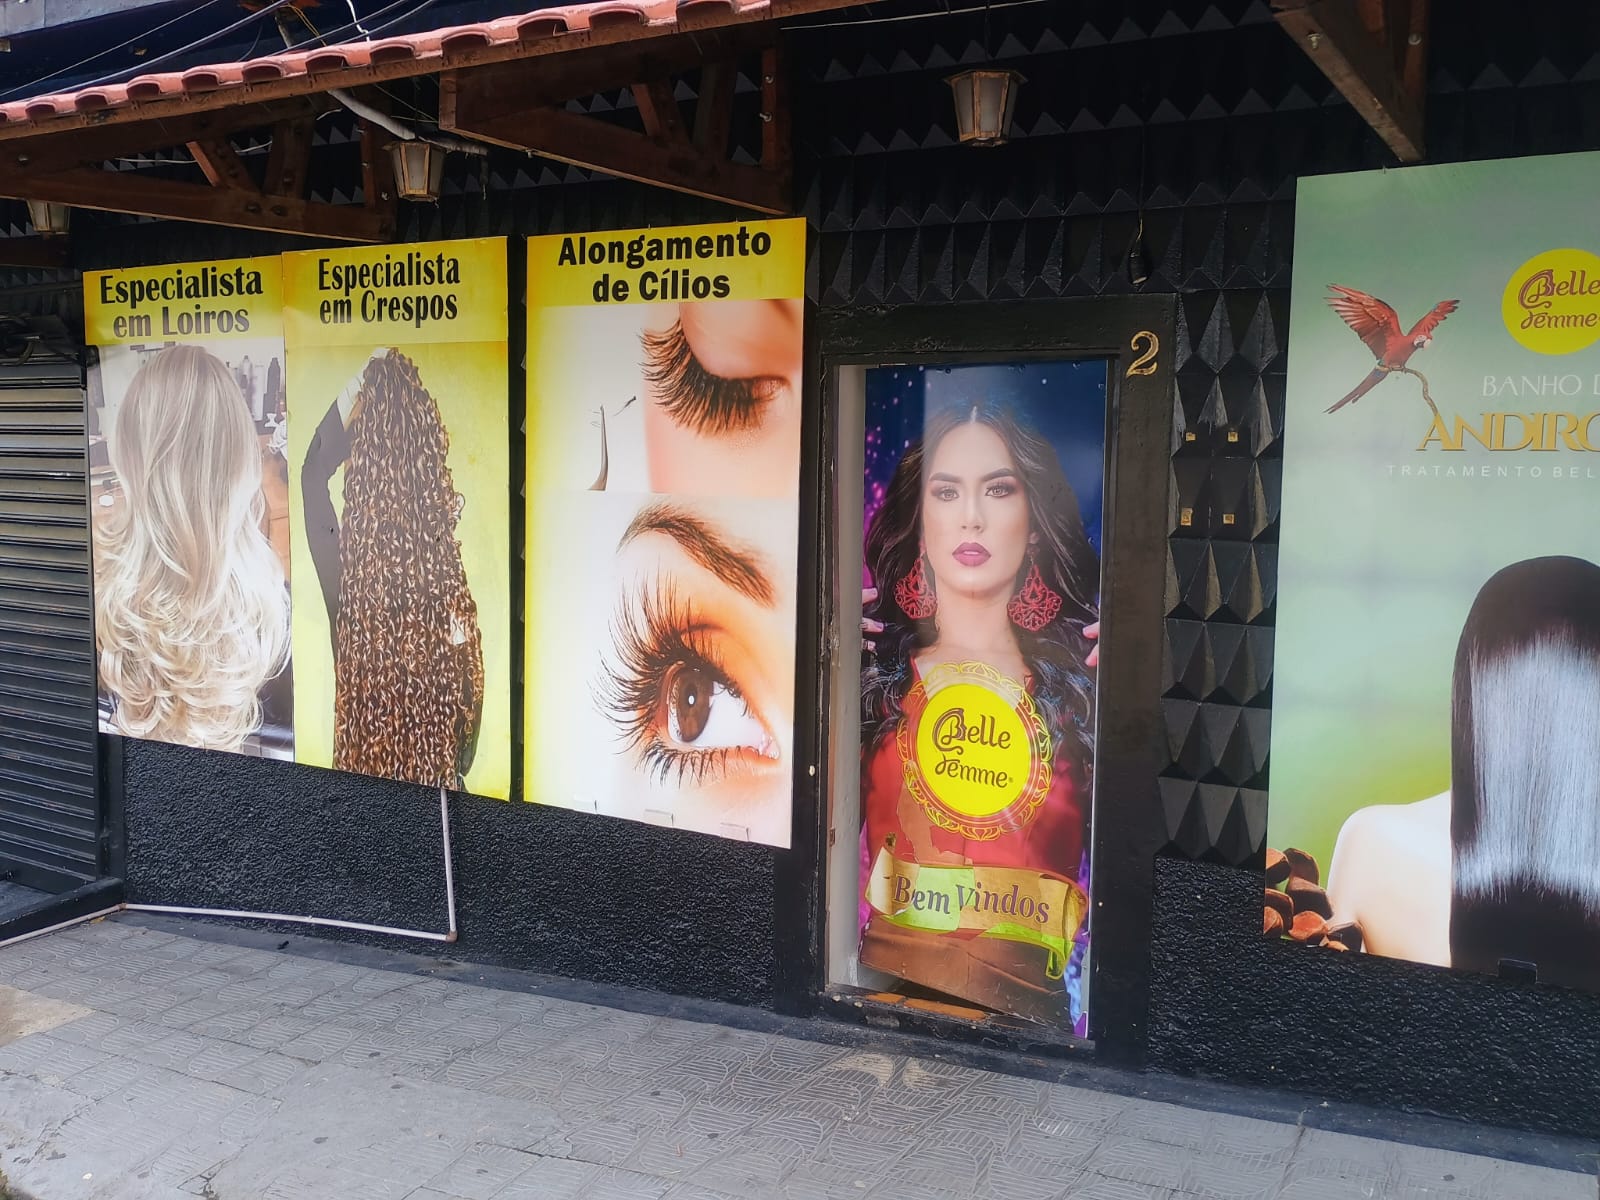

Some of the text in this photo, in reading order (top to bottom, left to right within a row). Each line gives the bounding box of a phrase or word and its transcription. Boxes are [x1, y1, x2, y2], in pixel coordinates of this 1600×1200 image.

[558, 226, 772, 269] Alongamento
[100, 267, 264, 308] Especialista
[318, 252, 460, 295] Especialista
[592, 268, 731, 302] de Cílios
[1518, 269, 1600, 310] Belle
[113, 306, 250, 338] em Loiros
[319, 289, 458, 329] em Crespos
[1126, 330, 1159, 379] 2
[1482, 374, 1582, 397] BANHO
[1387, 465, 1596, 479] TRATAMENTO BEL
[932, 707, 1011, 755] Belle
[894, 874, 1050, 924] Bem Vindos
